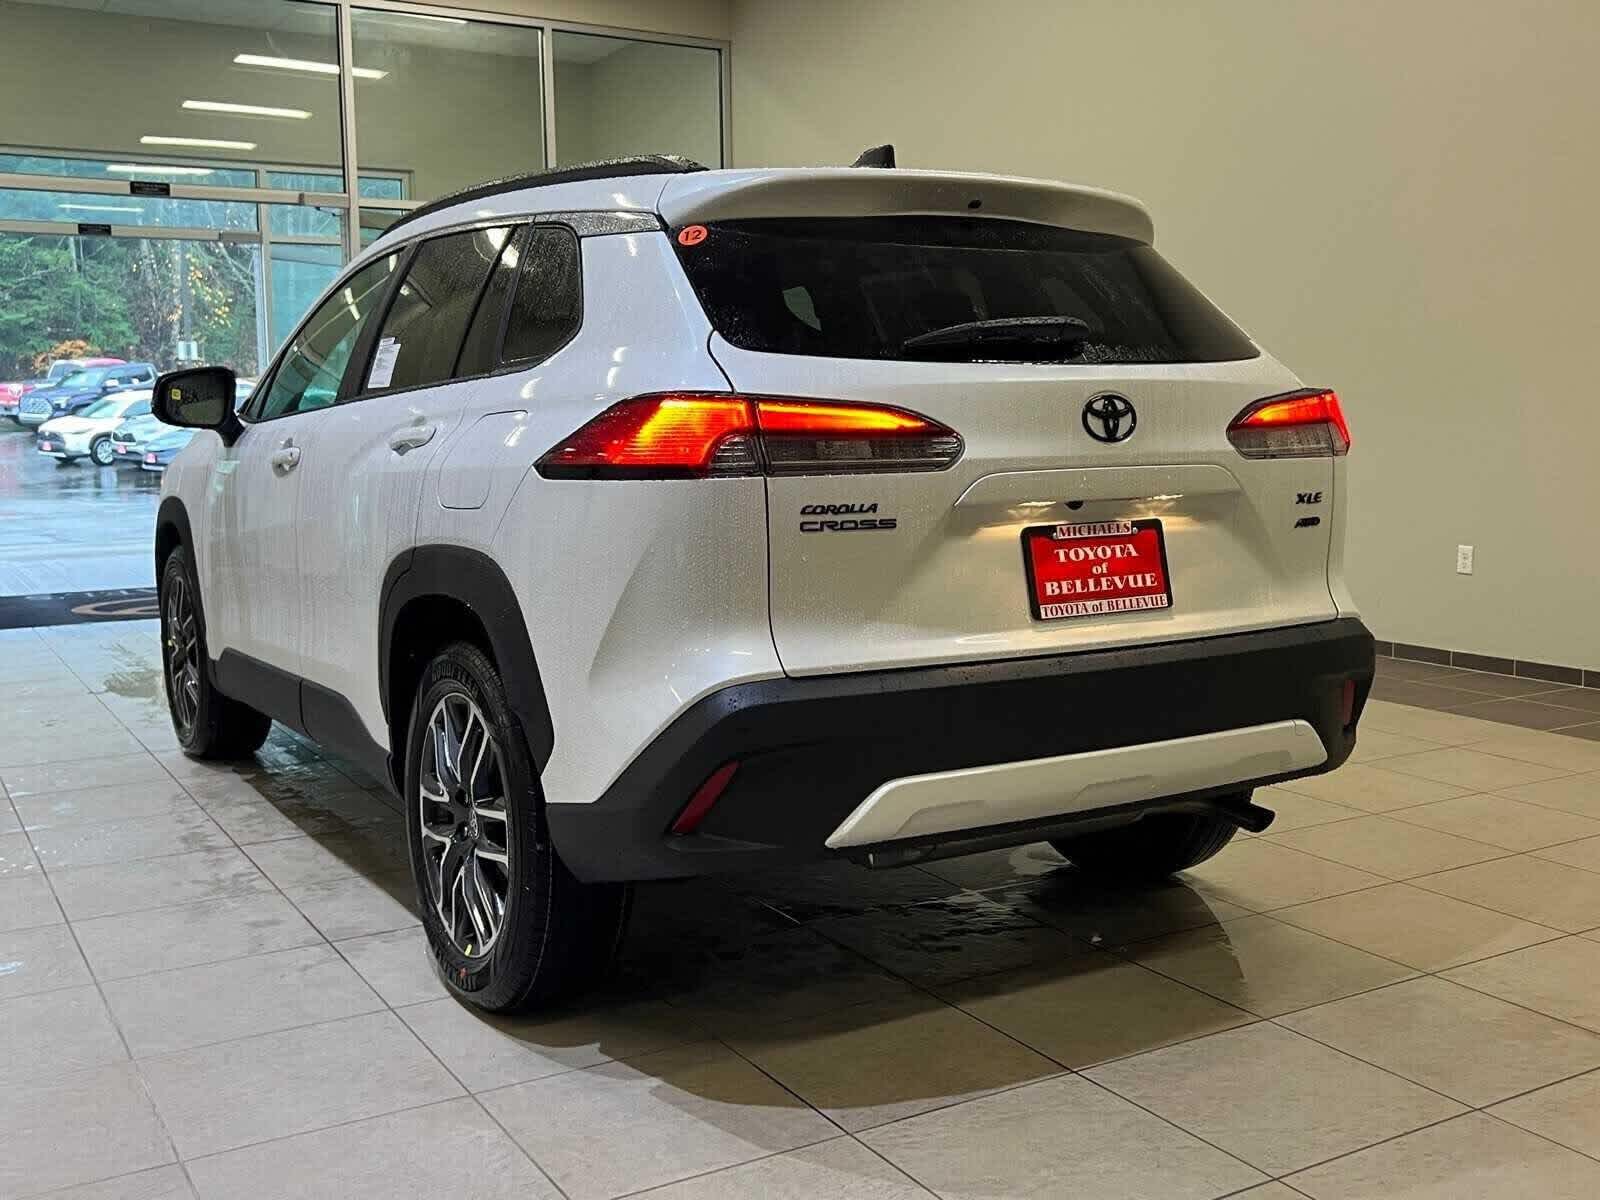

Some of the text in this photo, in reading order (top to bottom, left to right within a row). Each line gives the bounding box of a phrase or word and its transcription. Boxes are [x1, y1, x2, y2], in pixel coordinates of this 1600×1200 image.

[684, 229, 702, 241] 12
[1295, 491, 1322, 504] XLE
[800, 503, 878, 515] COROLLA
[800, 518, 897, 532] CROSS
[1058, 522, 1131, 538] MICHAELS
[1054, 543, 1139, 563] TOYOTA
[1092, 562, 1109, 575] of
[1044, 572, 1158, 596] BELLEVUE
[1041, 594, 1167, 618] TOYOTA of BELLEVUE
